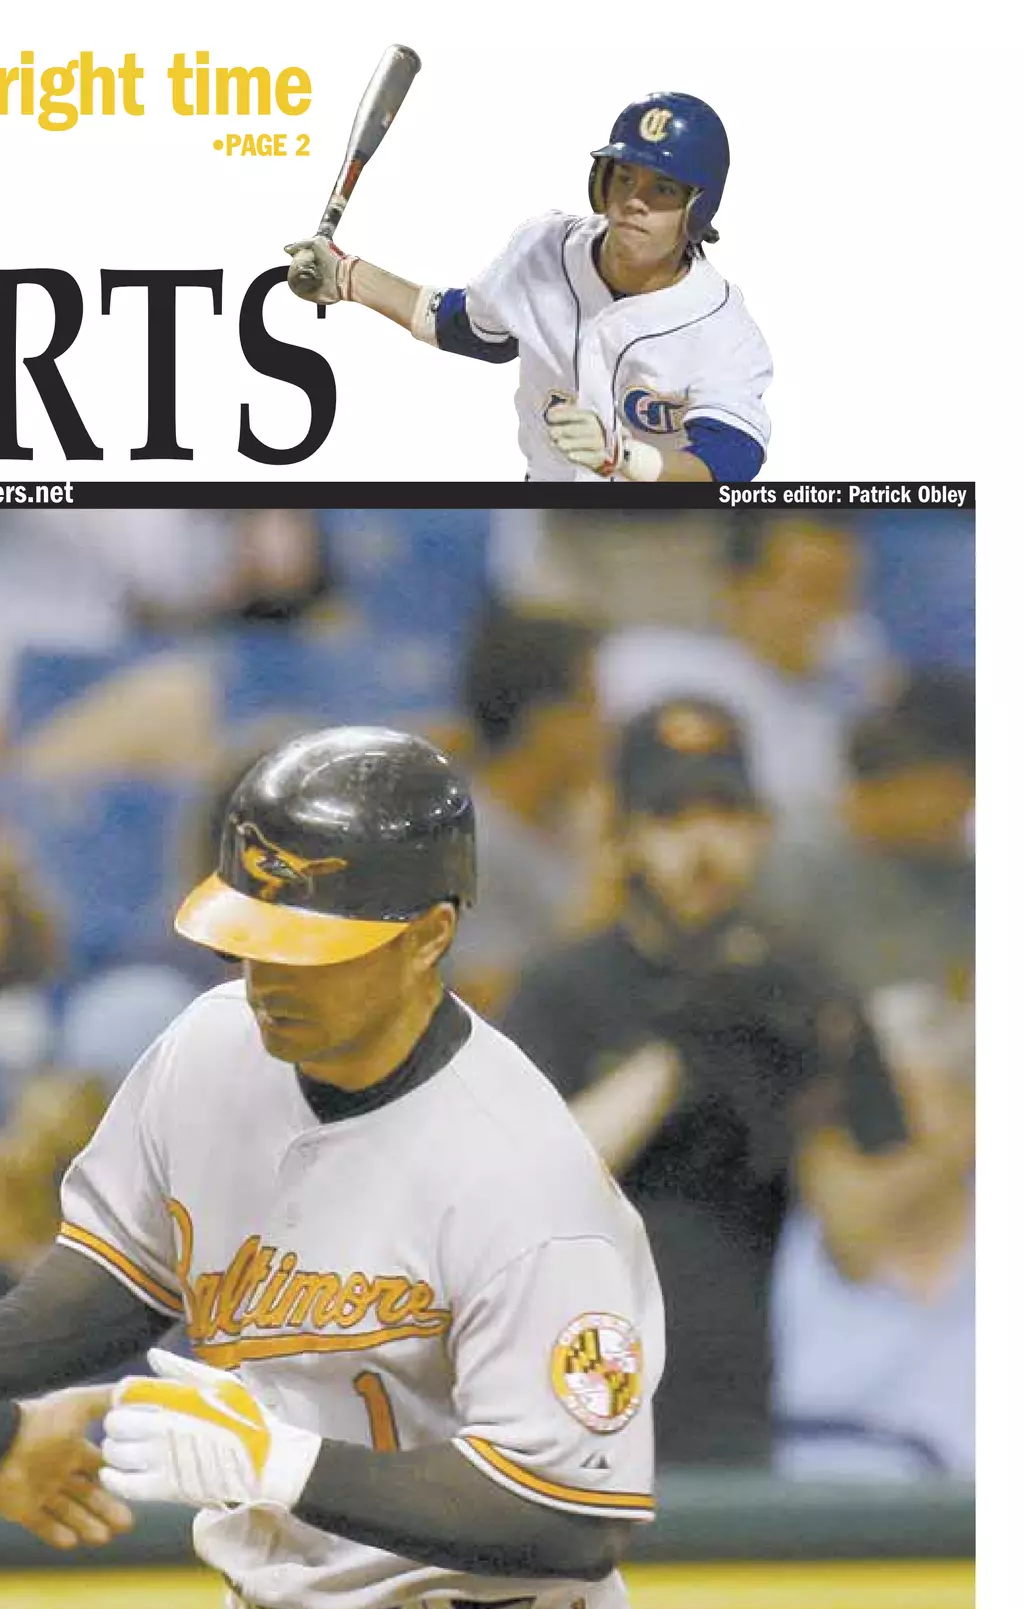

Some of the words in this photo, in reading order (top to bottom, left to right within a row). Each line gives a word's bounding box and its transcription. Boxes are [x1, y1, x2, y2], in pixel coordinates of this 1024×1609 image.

[167, 50, 313, 117] time
[295, 133, 311, 157] 2
[718, 485, 777, 507] Sports
[783, 485, 842, 503] editor:
[849, 485, 912, 503] Patrick
[918, 485, 967, 507] Obley
[163, 1197, 450, 1341] altimore
